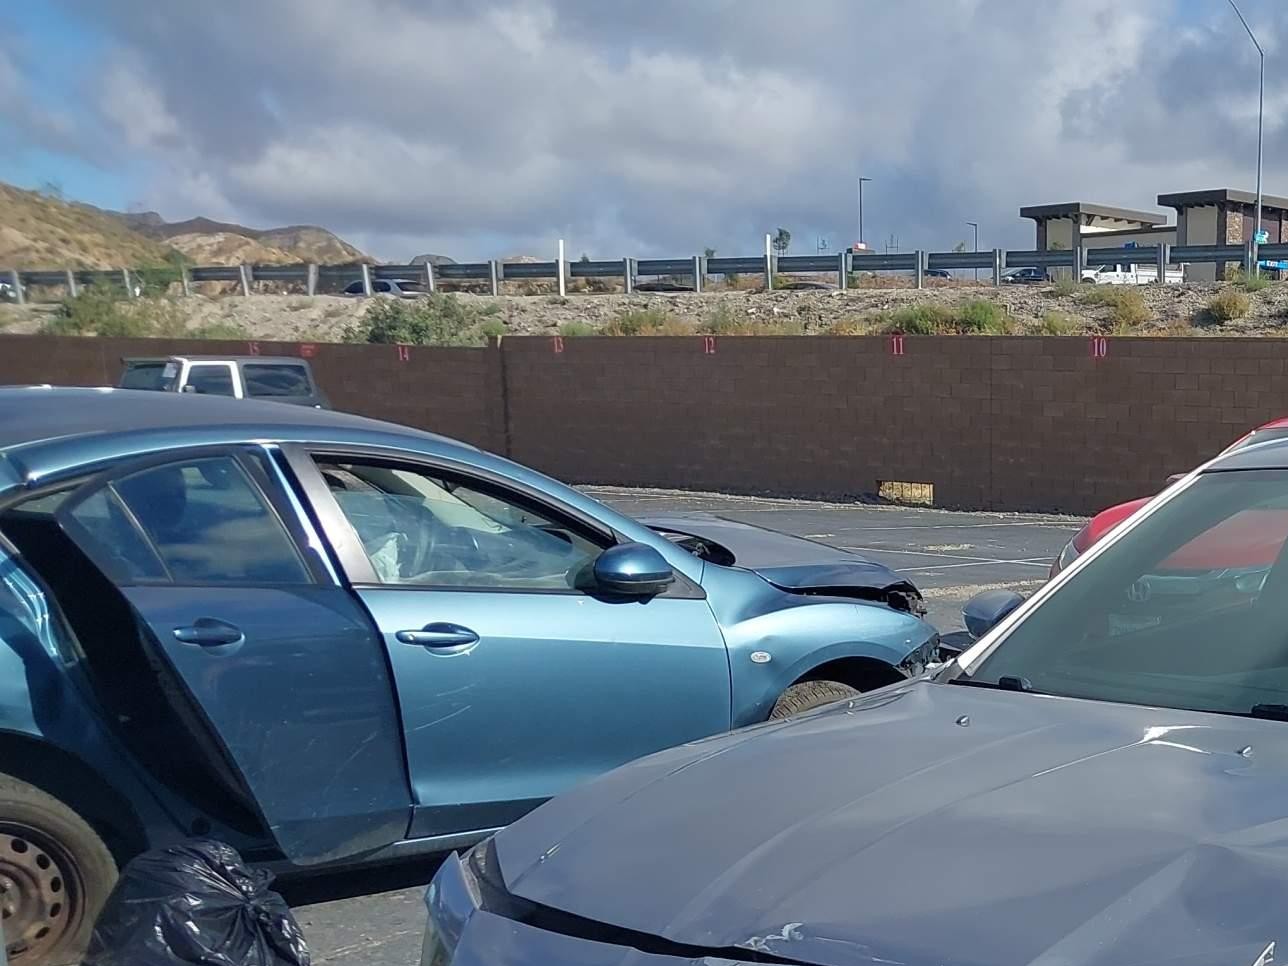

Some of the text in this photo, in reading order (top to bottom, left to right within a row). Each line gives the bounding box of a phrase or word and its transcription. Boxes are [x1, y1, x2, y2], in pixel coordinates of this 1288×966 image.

[705, 336, 715, 353] 12
[892, 337, 904, 355] 11
[1094, 337, 1107, 357] 10
